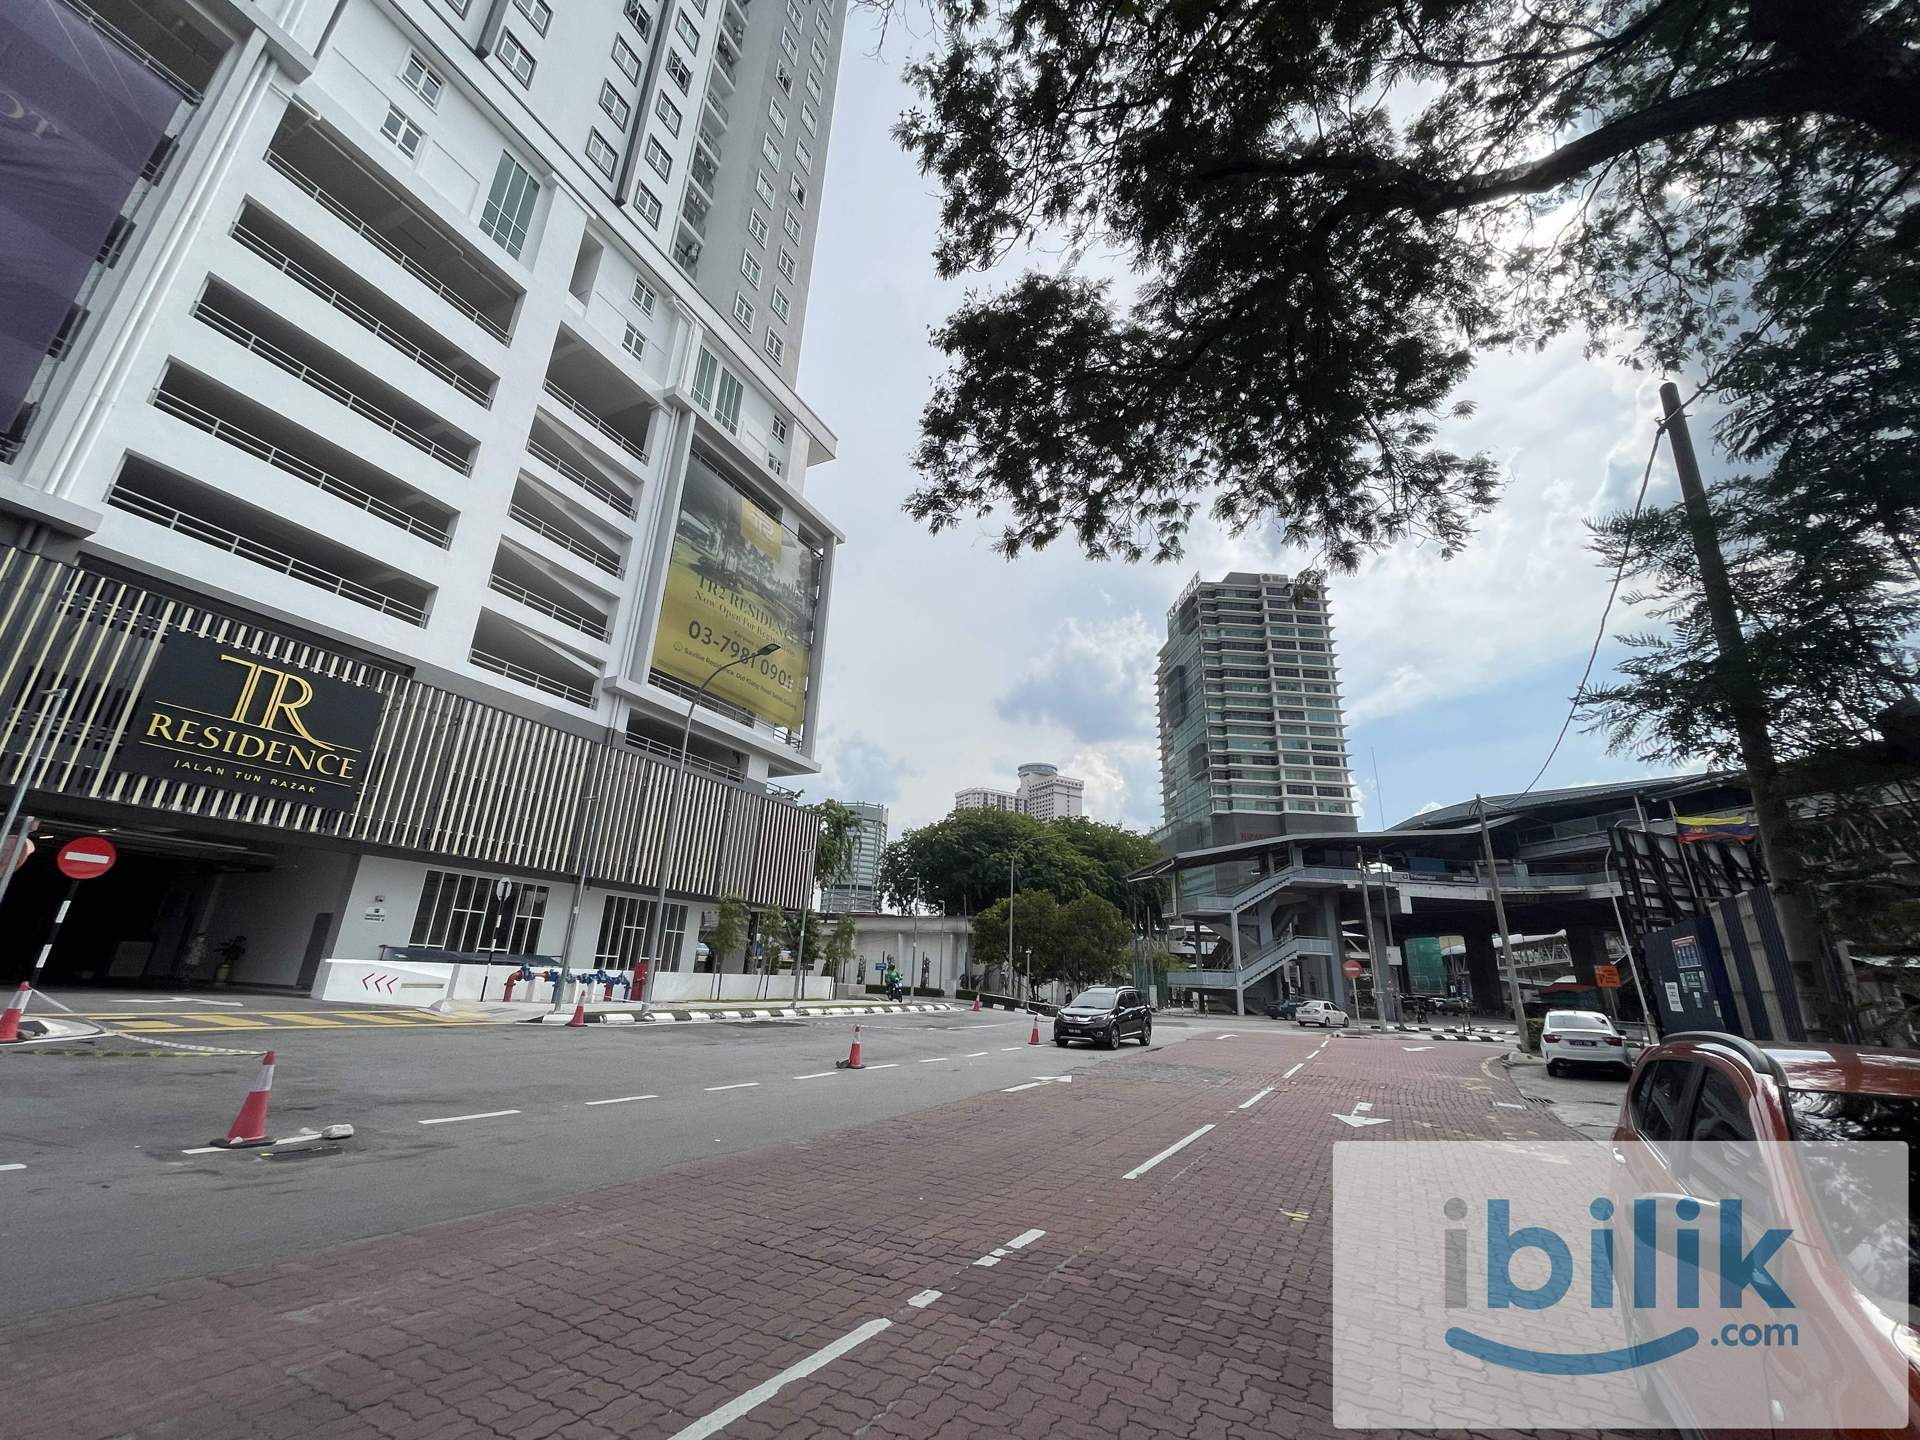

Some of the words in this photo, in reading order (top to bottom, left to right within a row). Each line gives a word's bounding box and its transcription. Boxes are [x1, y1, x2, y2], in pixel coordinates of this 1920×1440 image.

[1179, 570, 1201, 606] GLOVE
[729, 591, 797, 641] RESIDENC
[688, 620, 757, 668] 03-7981
[219, 654, 334, 751] TR
[146, 712, 357, 780] RESIDENCE
[173, 759, 225, 777] JALAN
[235, 771, 262, 783] TUN
[270, 778, 318, 794] RAZAK
